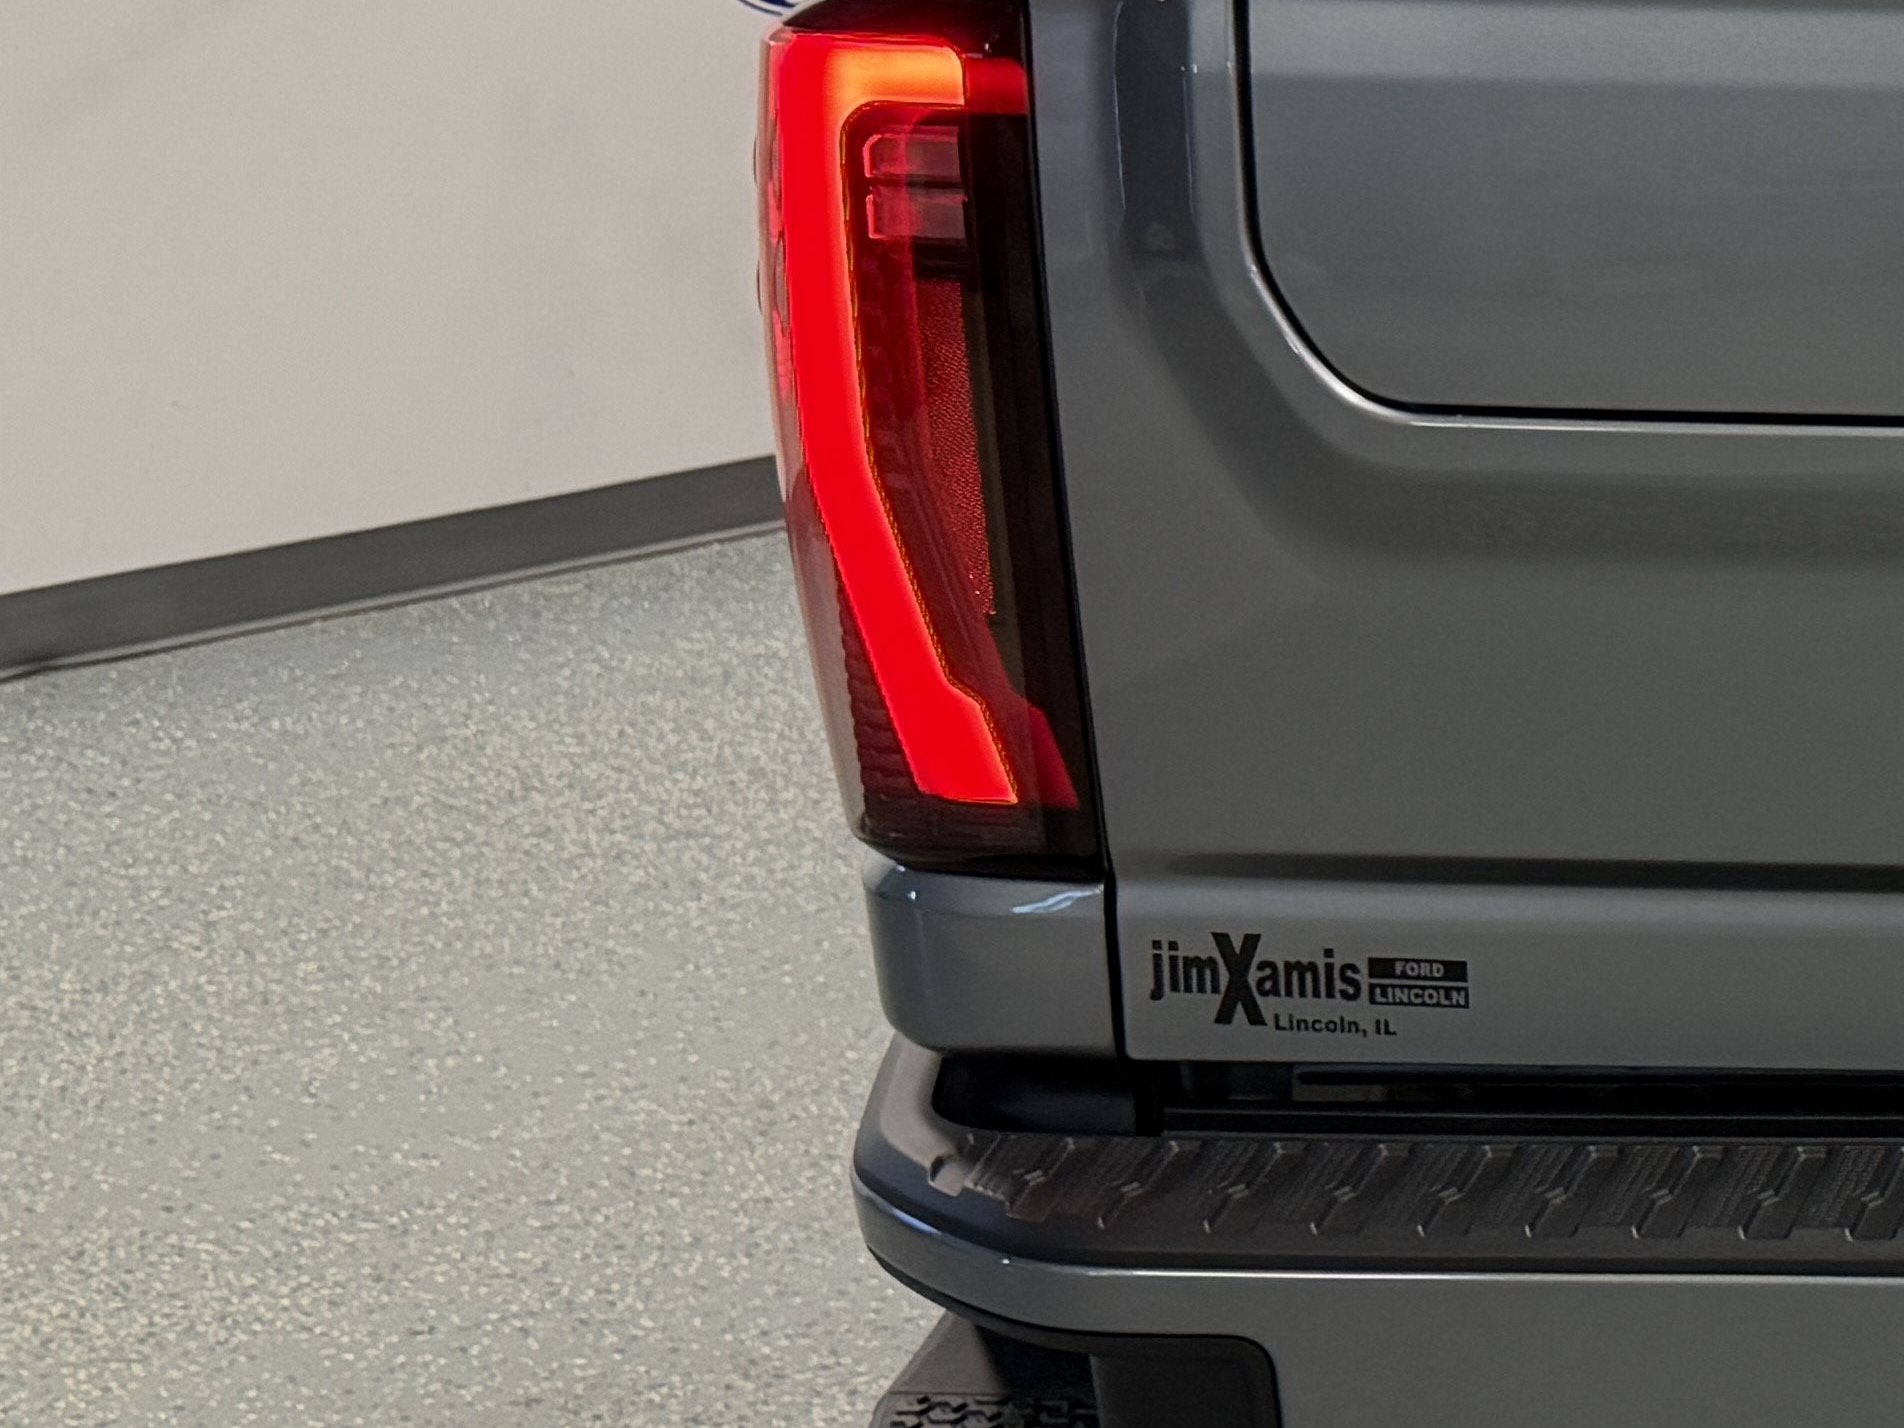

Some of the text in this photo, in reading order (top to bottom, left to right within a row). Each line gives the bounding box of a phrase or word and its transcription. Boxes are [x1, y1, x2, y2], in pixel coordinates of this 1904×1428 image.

[1394, 961, 1444, 978] FORD
[1375, 986, 1466, 1005] LINCOLN
[1273, 1012, 1398, 1038] Lincoln, IL
